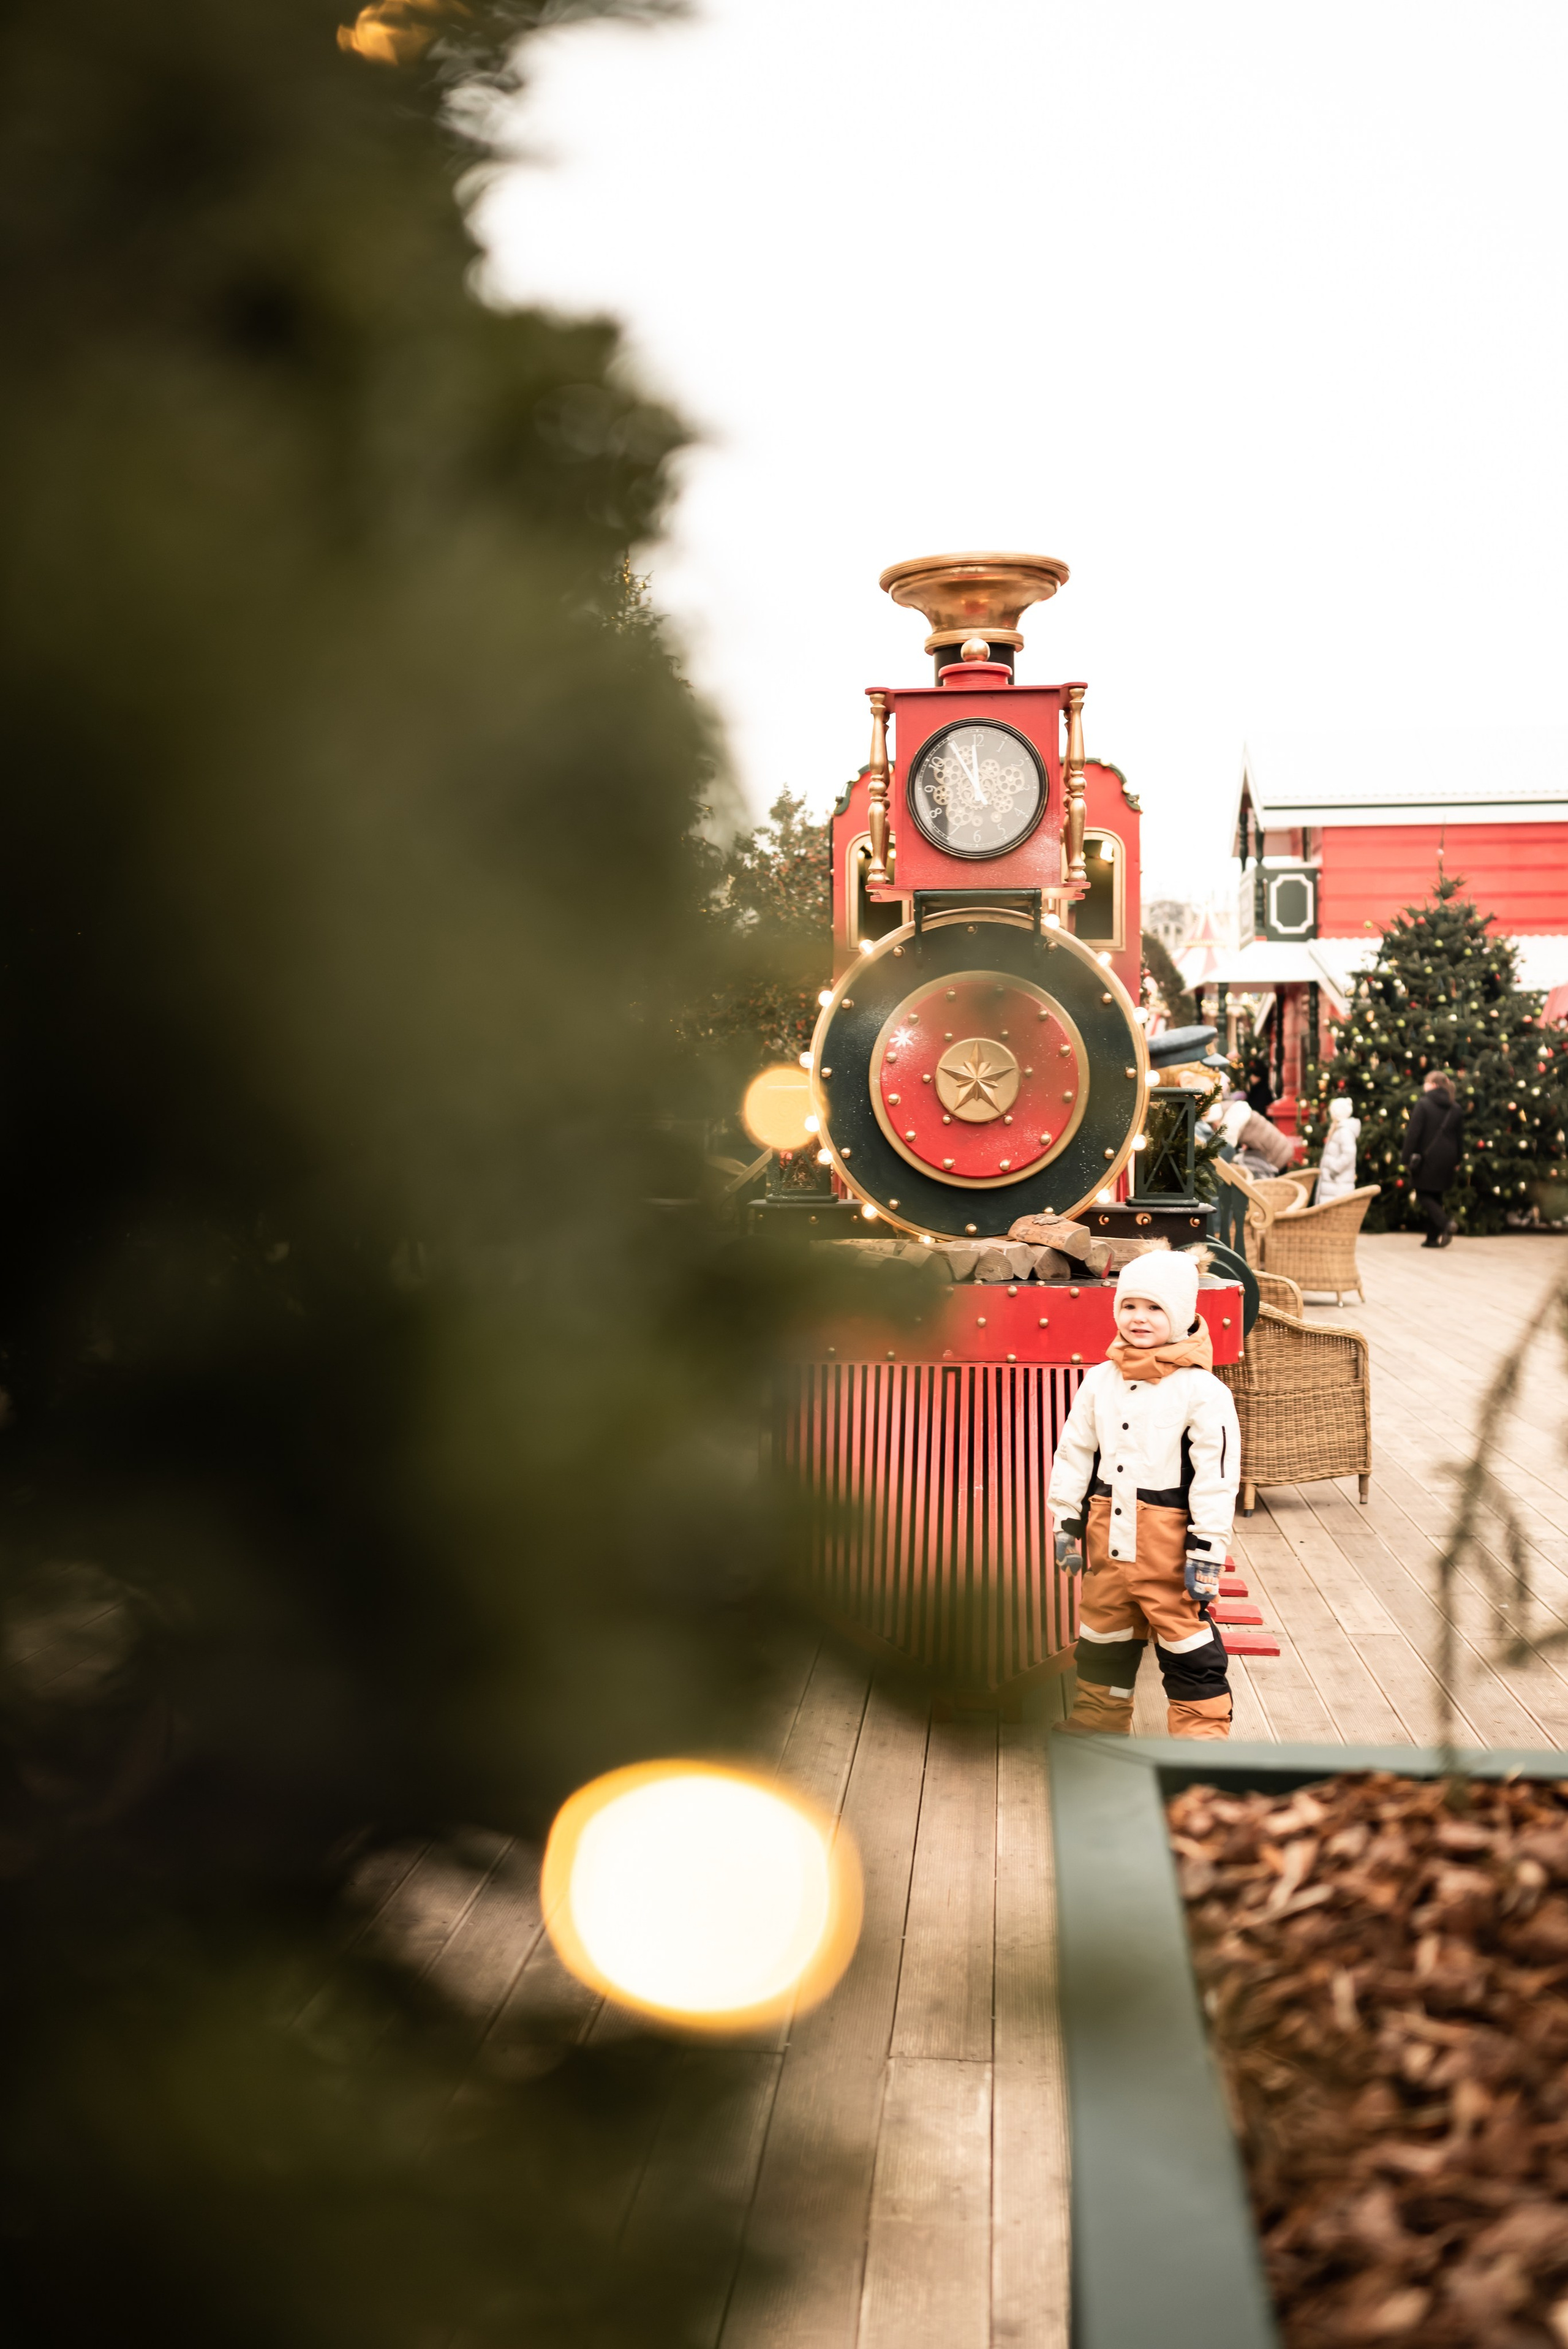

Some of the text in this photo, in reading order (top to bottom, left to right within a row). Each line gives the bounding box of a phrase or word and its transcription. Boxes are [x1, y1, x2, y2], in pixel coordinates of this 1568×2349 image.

[972, 734, 984, 747] 12
[997, 741, 1006, 753] 1
[929, 756, 944, 772] 10
[1011, 759, 1024, 767] 2
[929, 808, 942, 818] 8
[1014, 807, 1025, 816] 4
[949, 823, 960, 835] 7
[997, 823, 1006, 836] 5
[973, 830, 981, 843] 6
